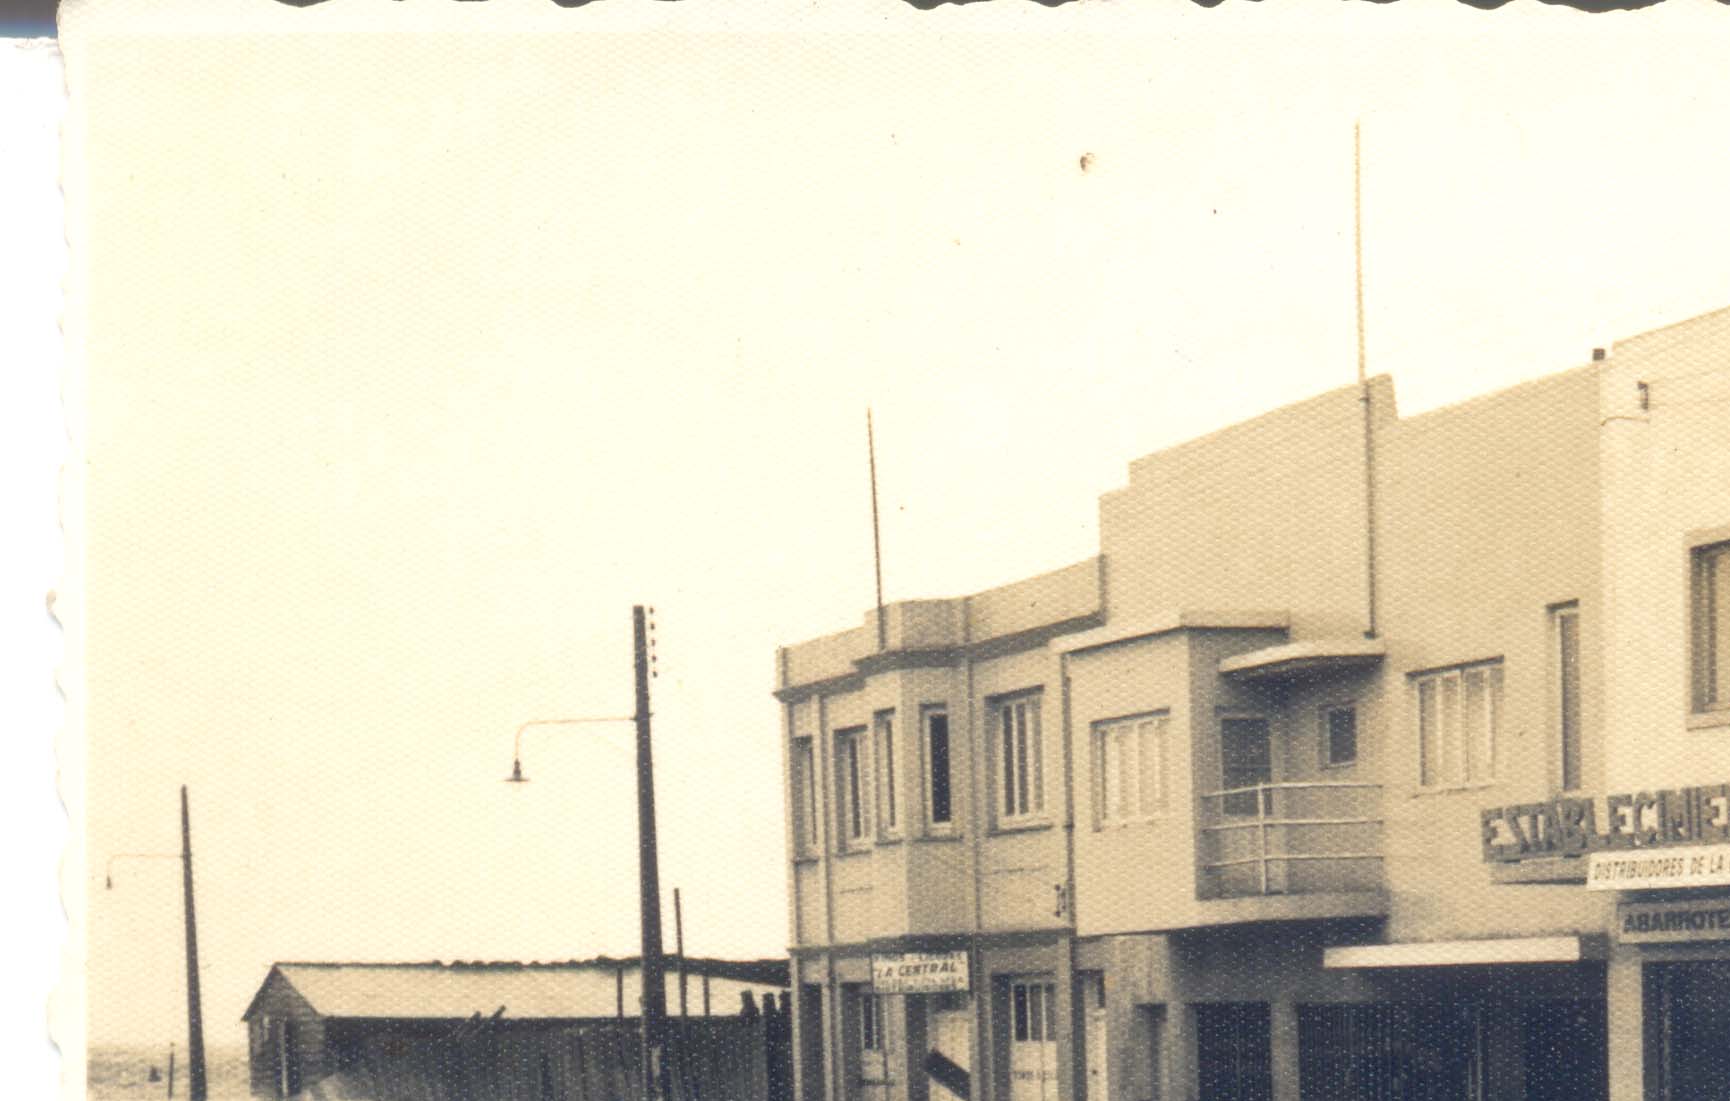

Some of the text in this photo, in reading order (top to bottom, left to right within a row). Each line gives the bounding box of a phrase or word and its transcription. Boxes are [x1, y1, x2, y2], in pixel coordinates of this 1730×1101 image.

[1593, 856, 1685, 881] DISTRIBUIDORES
[1690, 854, 1705, 876] DE
[1709, 853, 1724, 875] LA
[898, 961, 957, 977] CENTRAL
